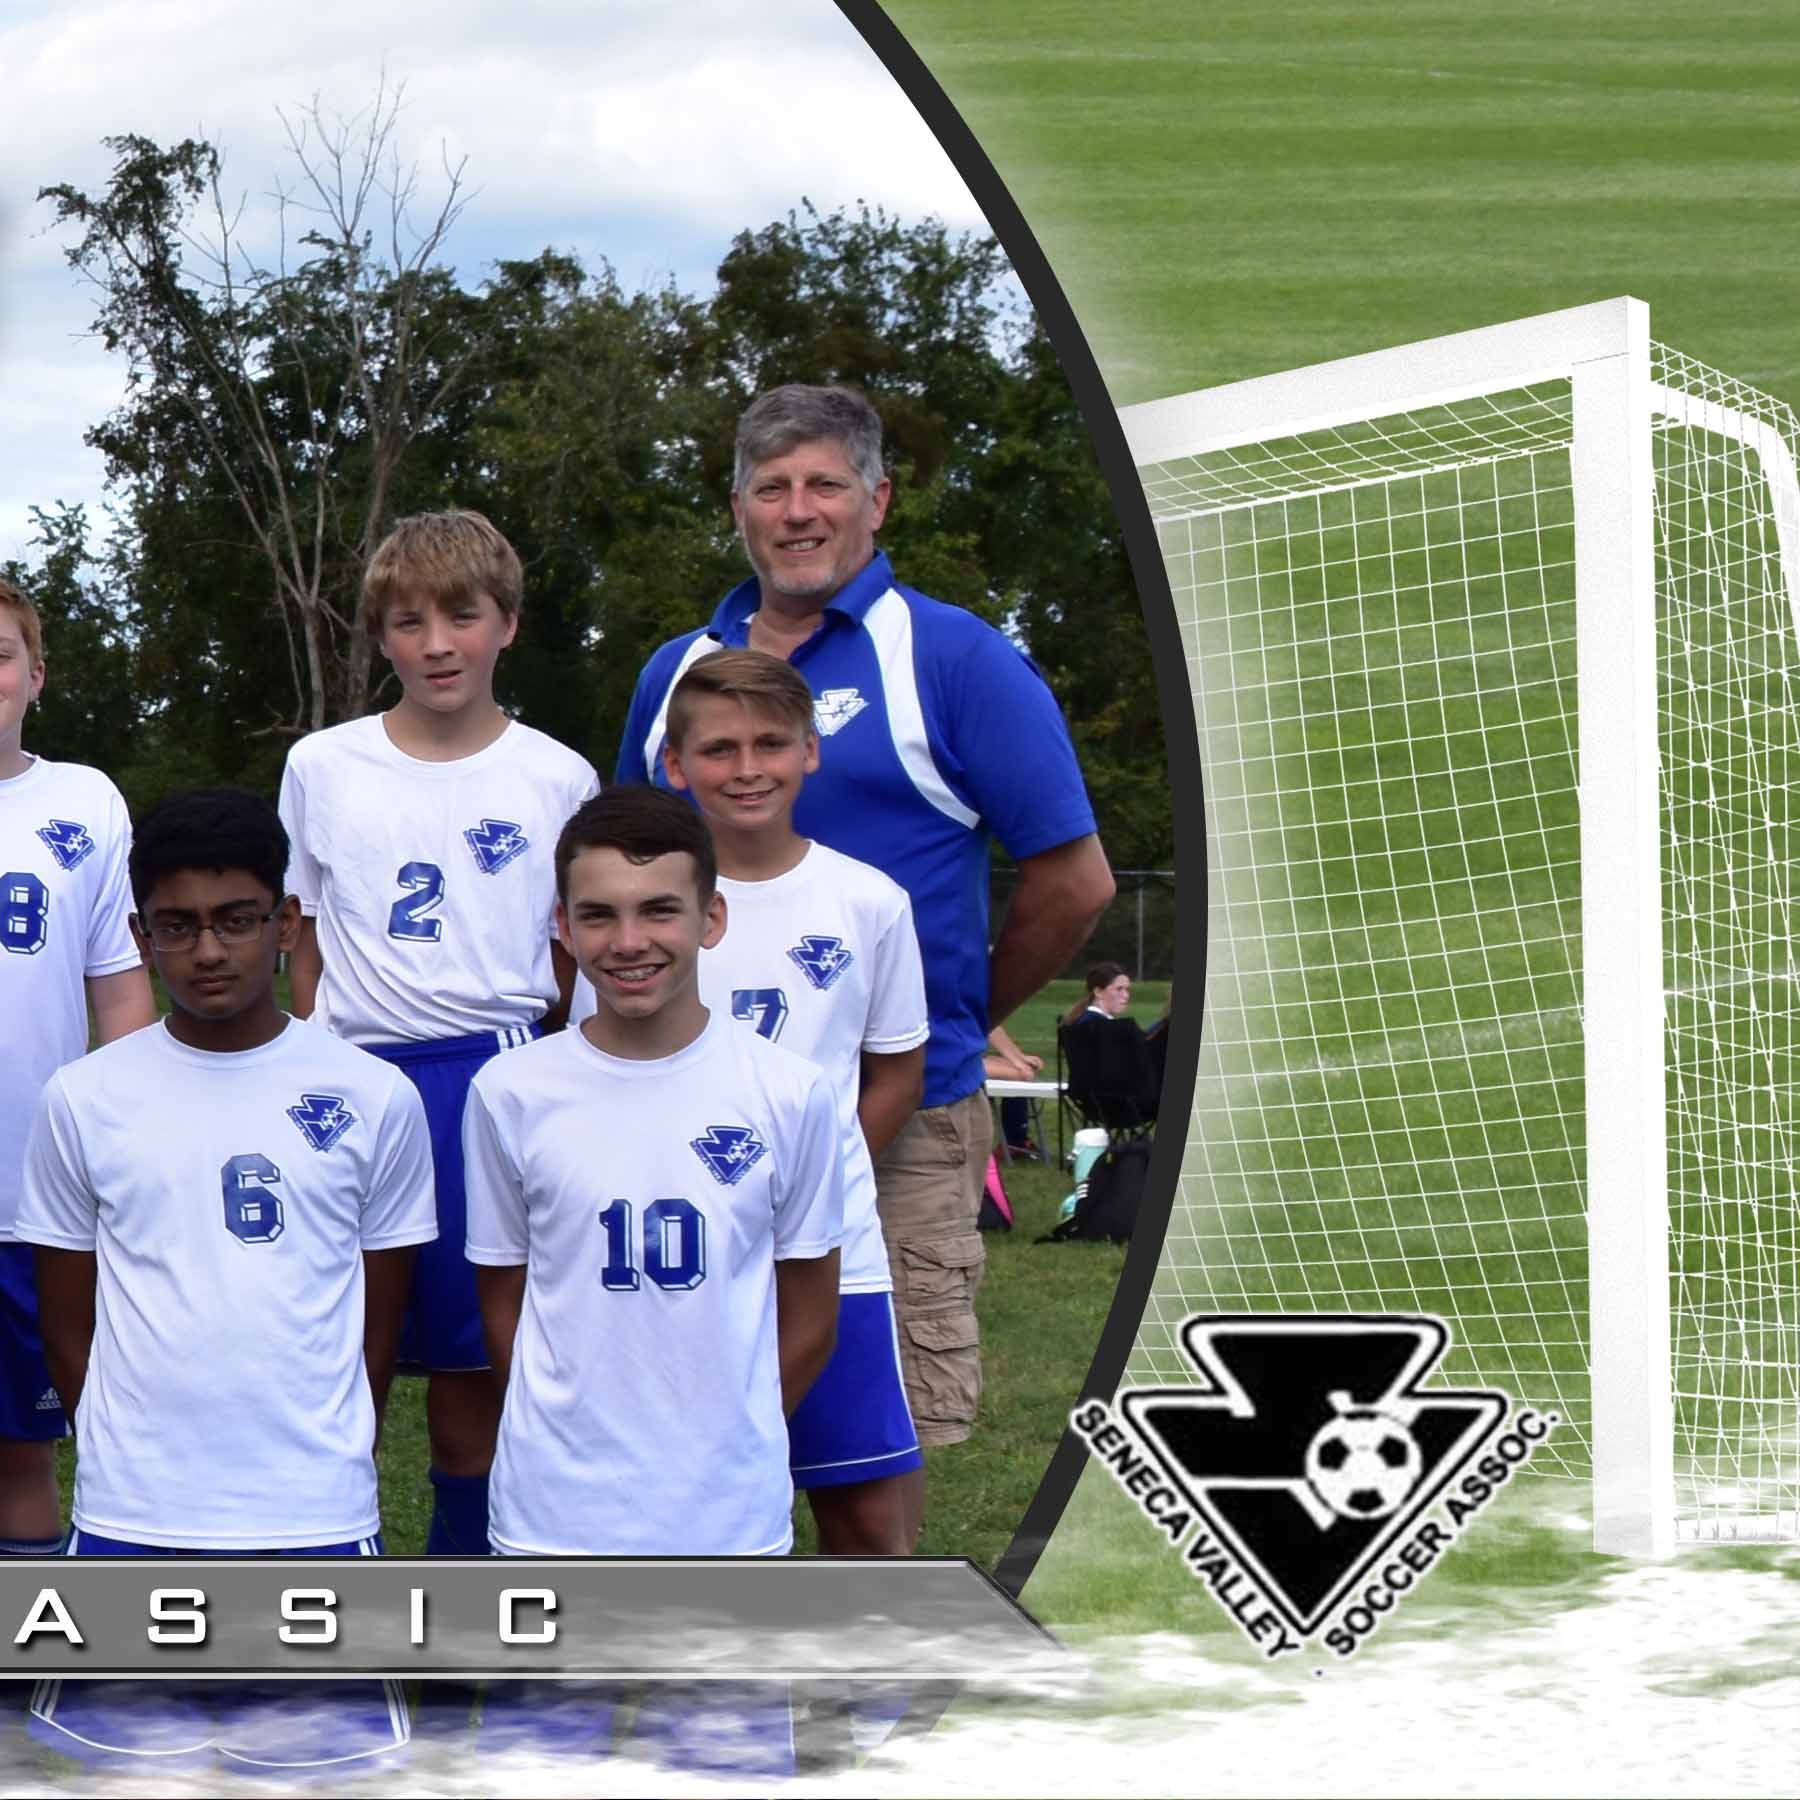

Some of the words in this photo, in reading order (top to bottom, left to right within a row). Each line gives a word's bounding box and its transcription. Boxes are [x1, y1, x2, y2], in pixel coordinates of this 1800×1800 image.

[388, 861, 445, 943] 2
[731, 988, 789, 1043] 7
[221, 1153, 286, 1245] 6
[599, 1198, 708, 1292] 10
